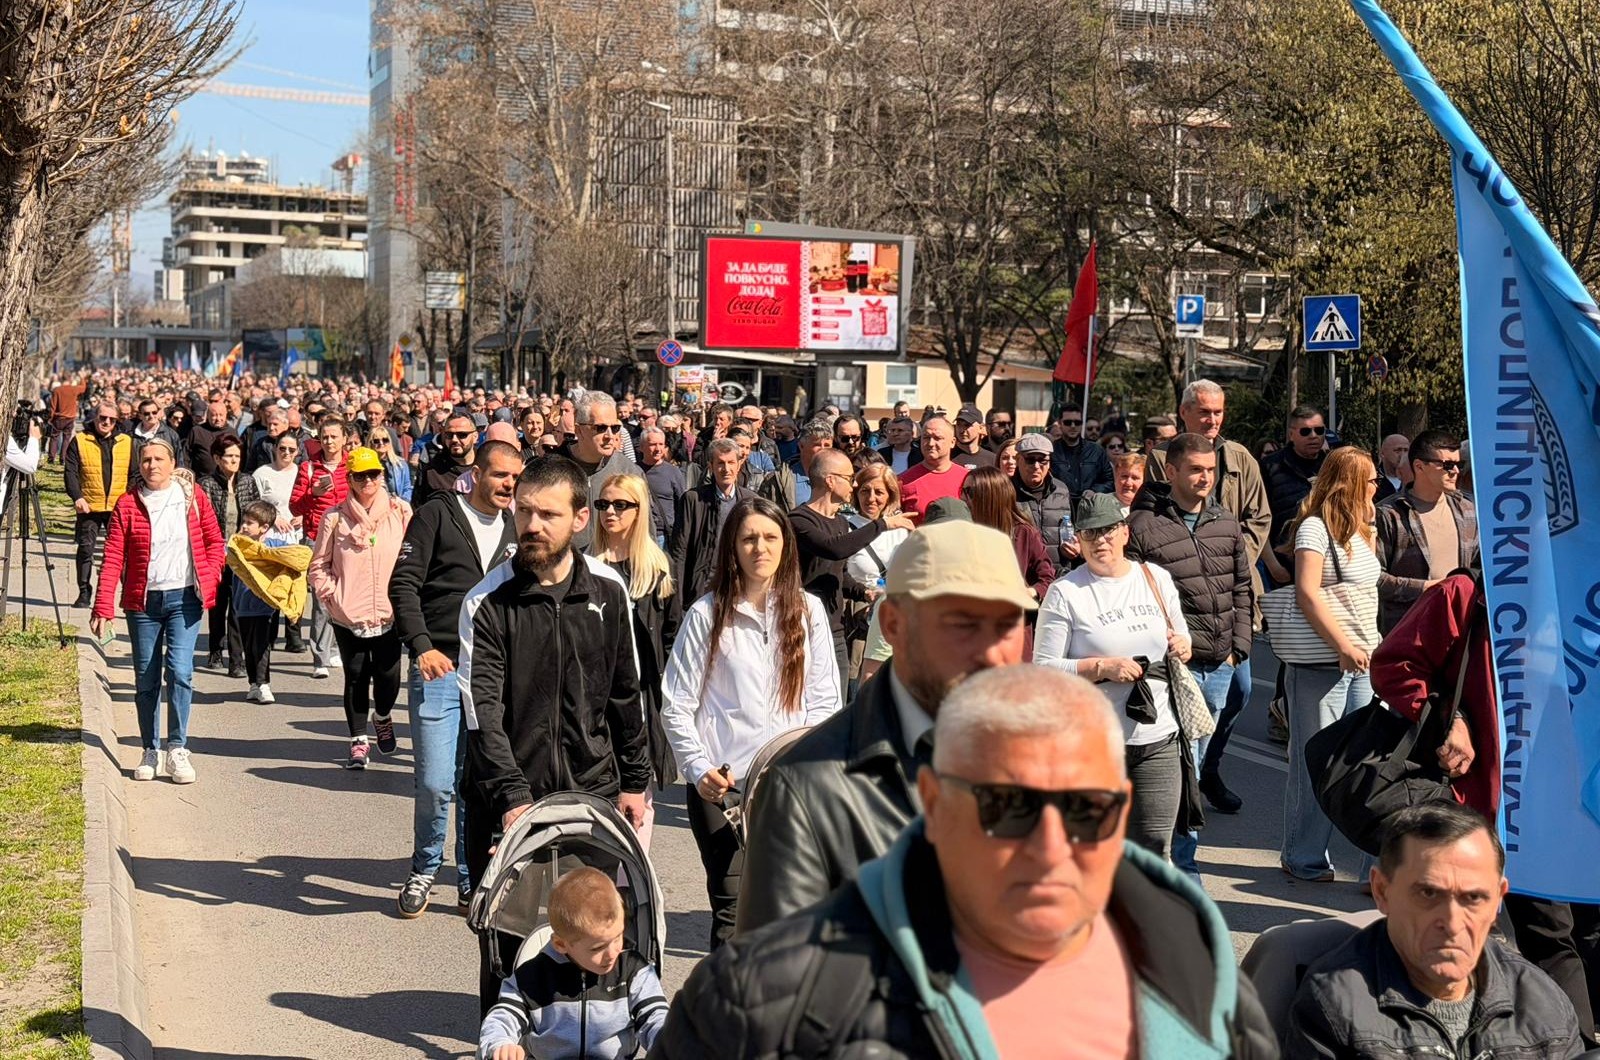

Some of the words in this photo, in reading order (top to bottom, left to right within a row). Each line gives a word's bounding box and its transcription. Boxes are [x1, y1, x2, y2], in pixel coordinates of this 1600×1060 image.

[1182, 298, 1198, 322] P
[1096, 608, 1125, 626] NEW
[1129, 603, 1162, 618] YORK
